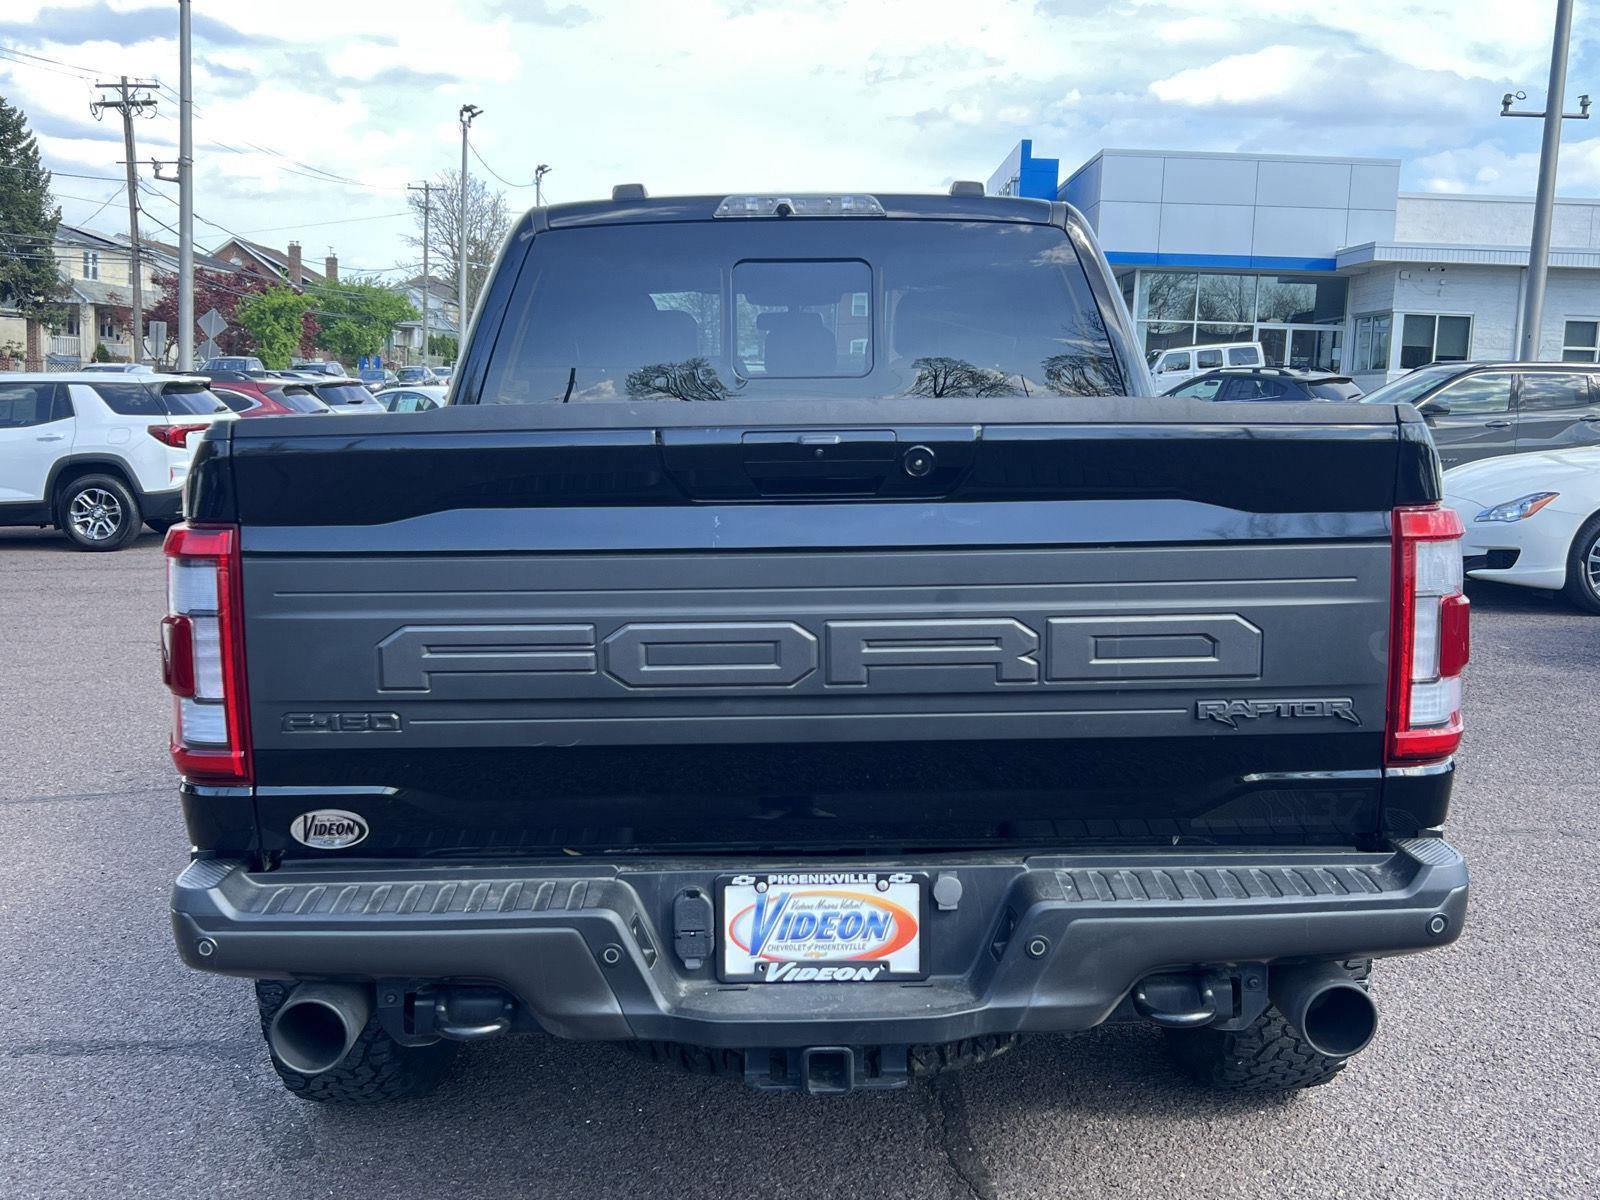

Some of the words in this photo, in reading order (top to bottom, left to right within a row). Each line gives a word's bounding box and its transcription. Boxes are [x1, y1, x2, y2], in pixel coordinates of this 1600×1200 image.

[376, 613, 1264, 693] FORD
[281, 711, 402, 733] F-150
[1196, 698, 1363, 730] RAPTOR
[303, 815, 356, 842] VIDEON
[768, 873, 877, 885] PHOENIXVILLE
[749, 892, 894, 959] VIDEON
[767, 943, 806, 952] CHEVROLET
[813, 942, 867, 951] PHOENIXVILLE
[765, 962, 880, 982] VIDEON
